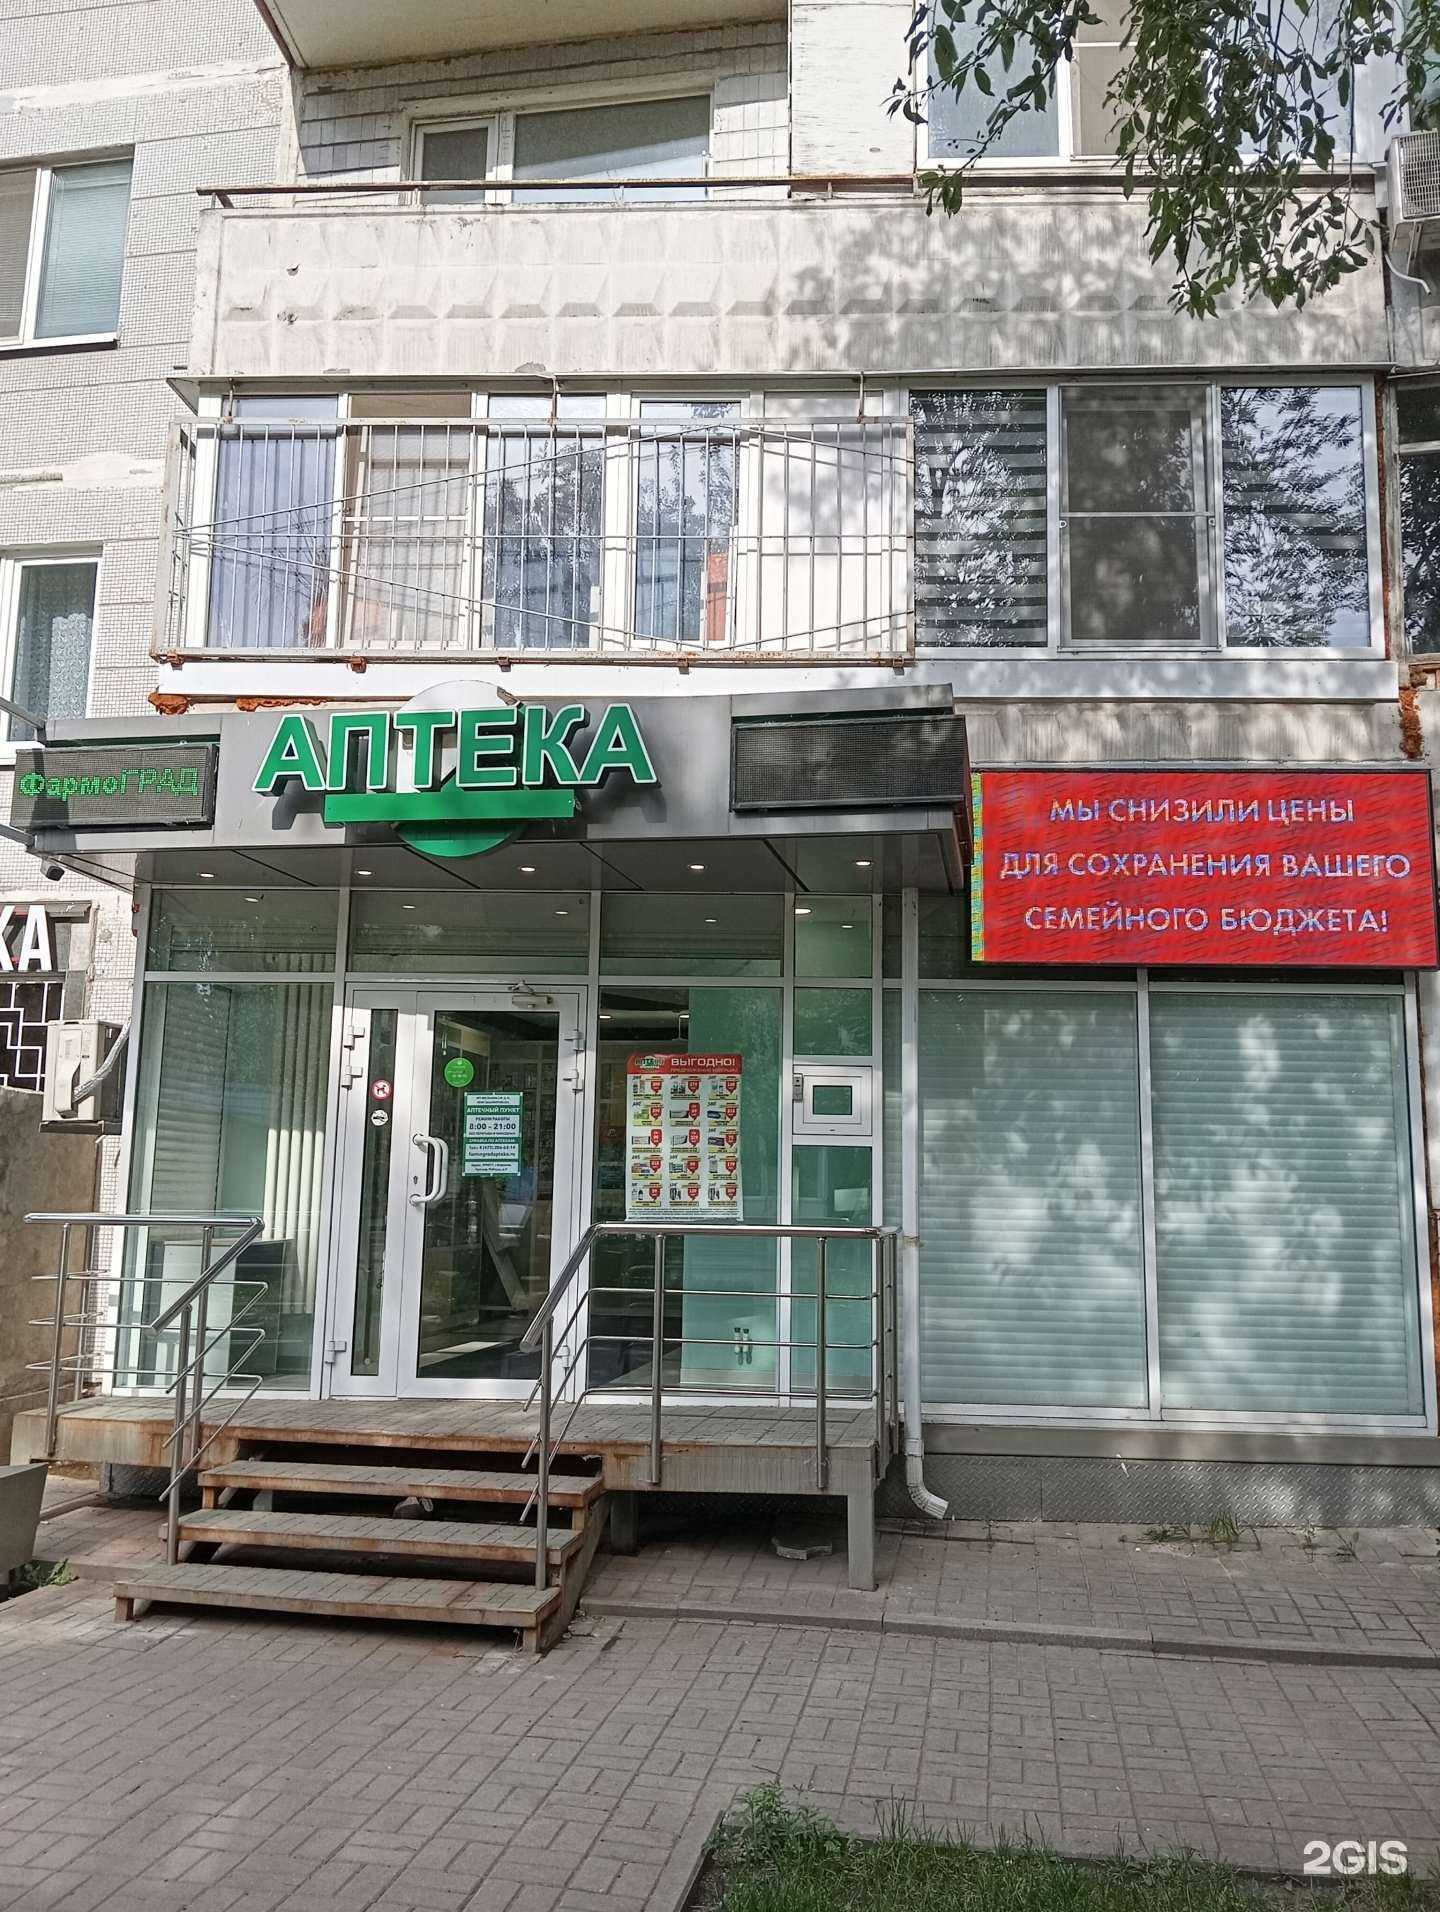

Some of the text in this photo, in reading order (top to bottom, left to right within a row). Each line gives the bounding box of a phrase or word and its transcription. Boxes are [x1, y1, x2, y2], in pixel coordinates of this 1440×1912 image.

[252, 703, 657, 794] АПТЕКА
[19, 767, 198, 801] ФармоГРАД
[1049, 798, 1354, 826] МЫ СНИЗИЛИ ЦЕНЫ
[1000, 853, 1411, 880] ДЛЯ СОХРАНЕНИЯ ВАШЕГО
[1024, 900, 1389, 936] СЕМЕЙНОГО БЮДЖЕТА!
[671, 1058, 735, 1068] ВЫГОДНО!
